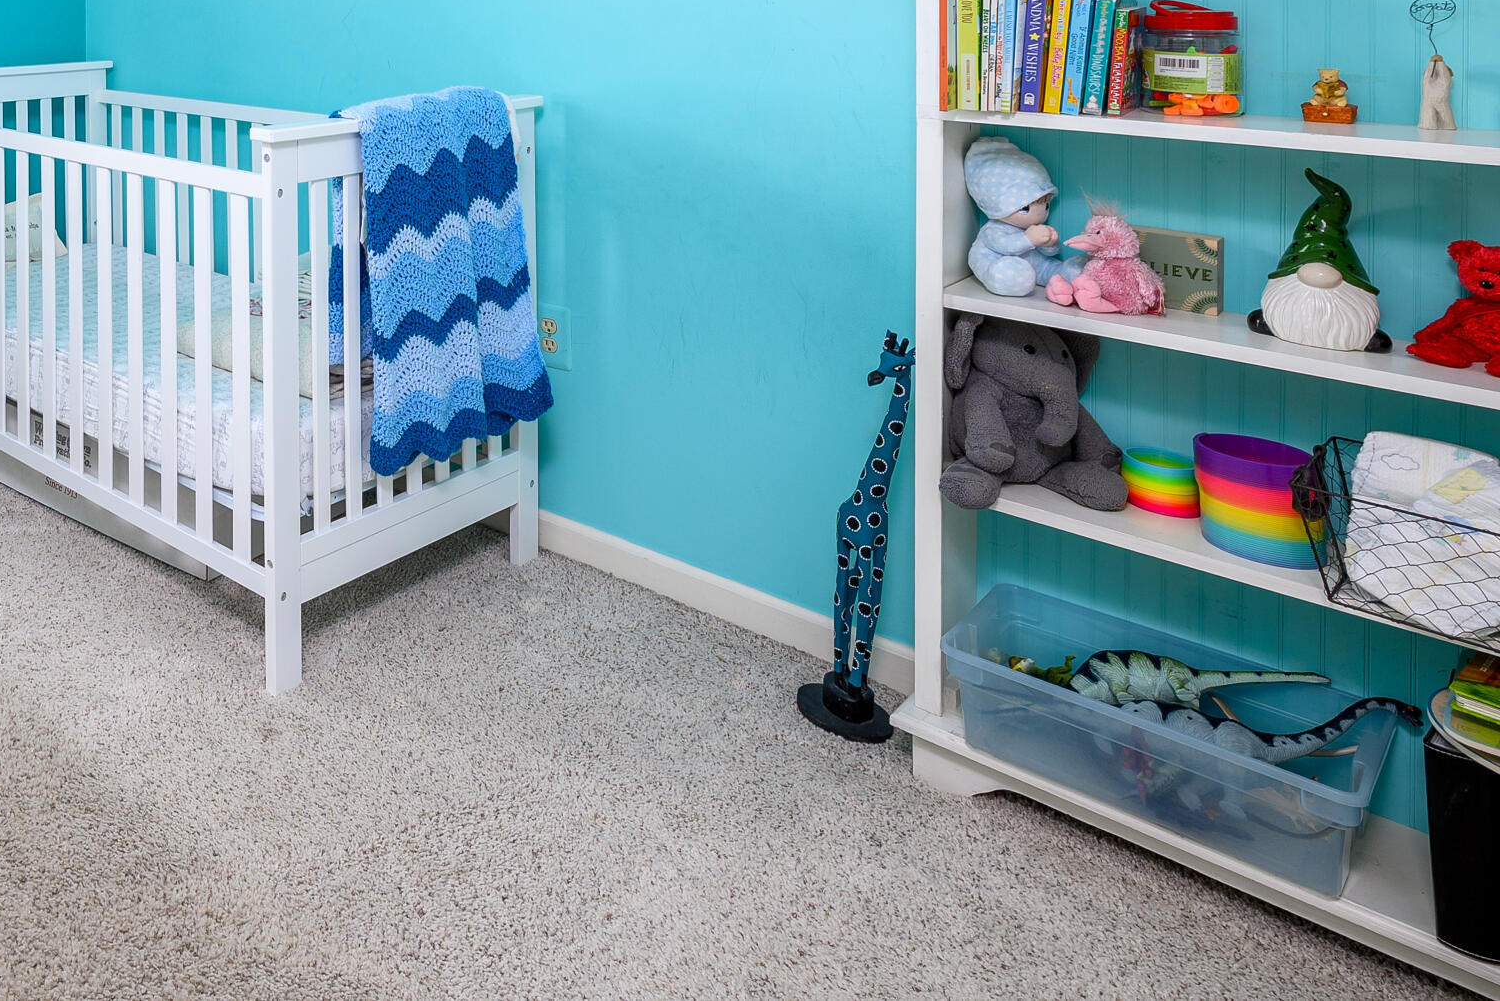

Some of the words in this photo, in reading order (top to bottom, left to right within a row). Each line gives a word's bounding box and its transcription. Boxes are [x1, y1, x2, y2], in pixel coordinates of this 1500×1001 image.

[961, 12, 973, 24] YOU
[1024, 42, 1039, 82] WISHES
[1088, 54, 1105, 94] DINOSAURS!
[45, 476, 62, 491] Since
[64, 487, 78, 499] 1913
